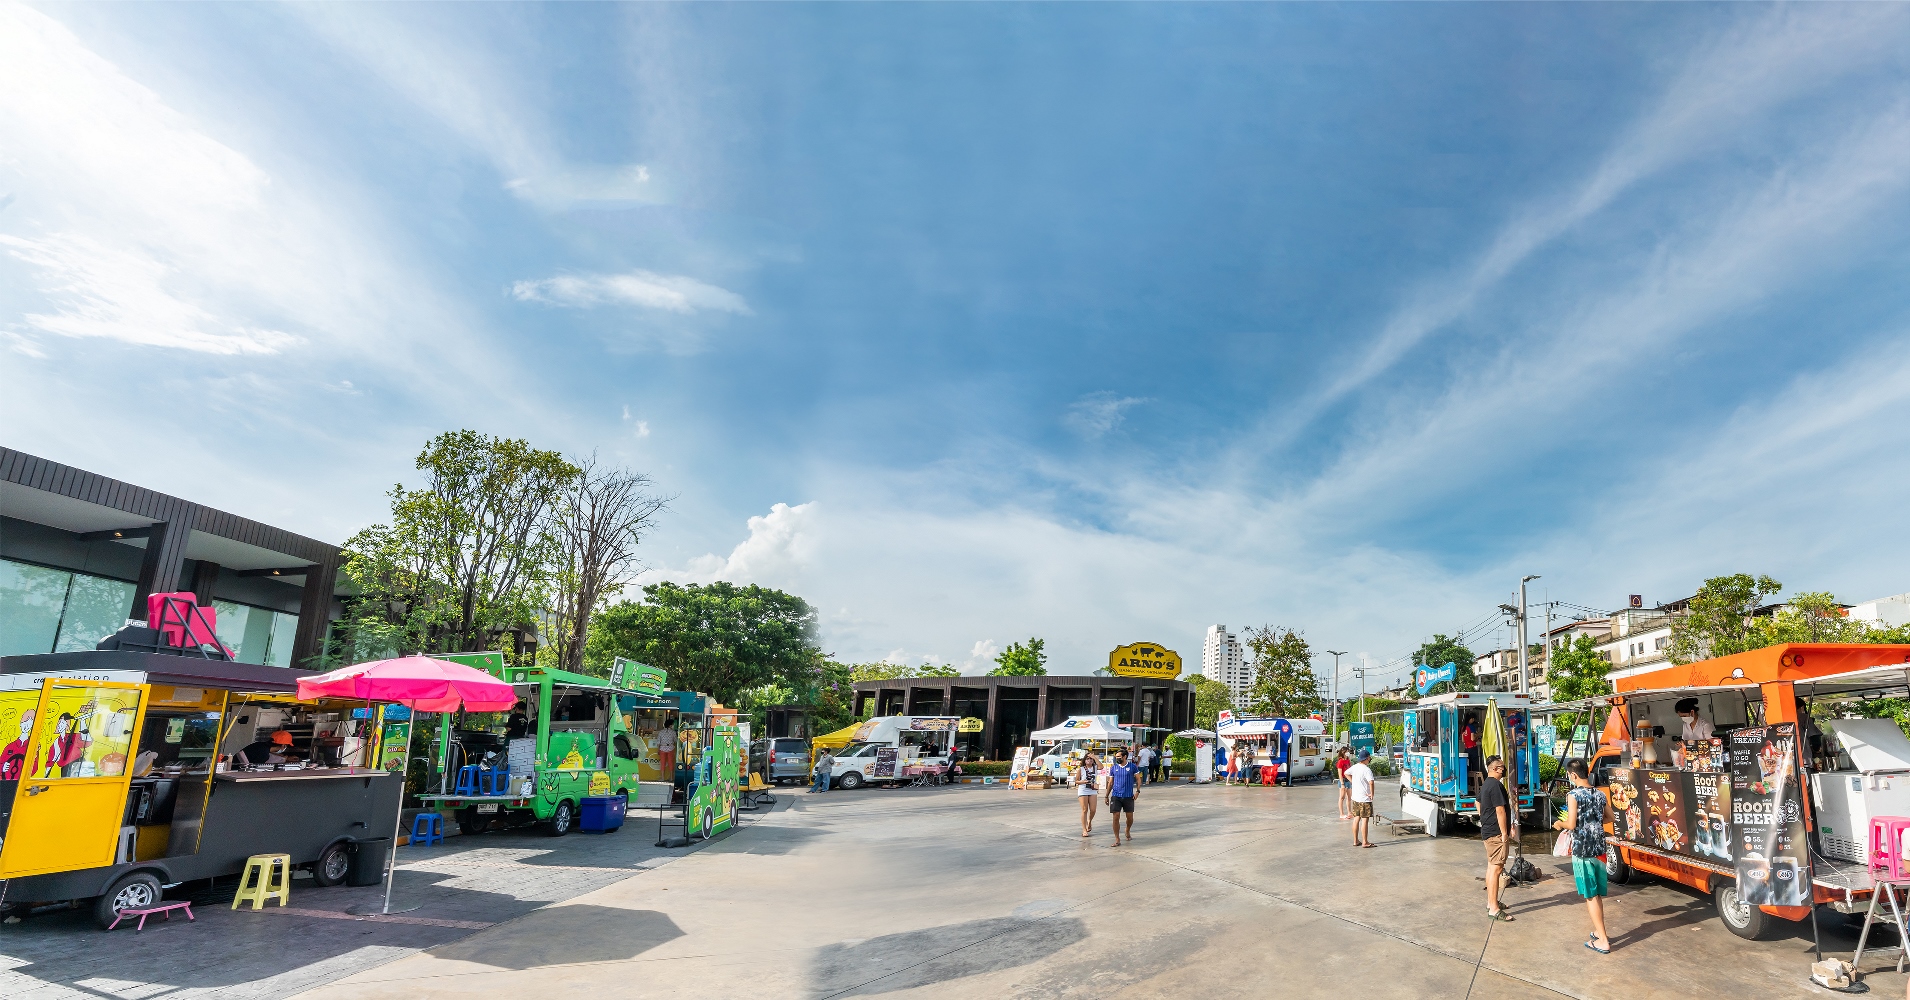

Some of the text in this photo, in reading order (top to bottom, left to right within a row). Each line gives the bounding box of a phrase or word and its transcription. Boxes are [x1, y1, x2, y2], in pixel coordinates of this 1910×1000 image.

[1118, 657, 1175, 671] ARNO'S
[1064, 720, 1093, 729] B2S
[1734, 736, 1762, 744] TREATS
[1694, 776, 1717, 787] ROOT
[1695, 786, 1719, 797] BEER
[1733, 802, 1773, 813] ROOT
[1733, 813, 1776, 825] BEER
